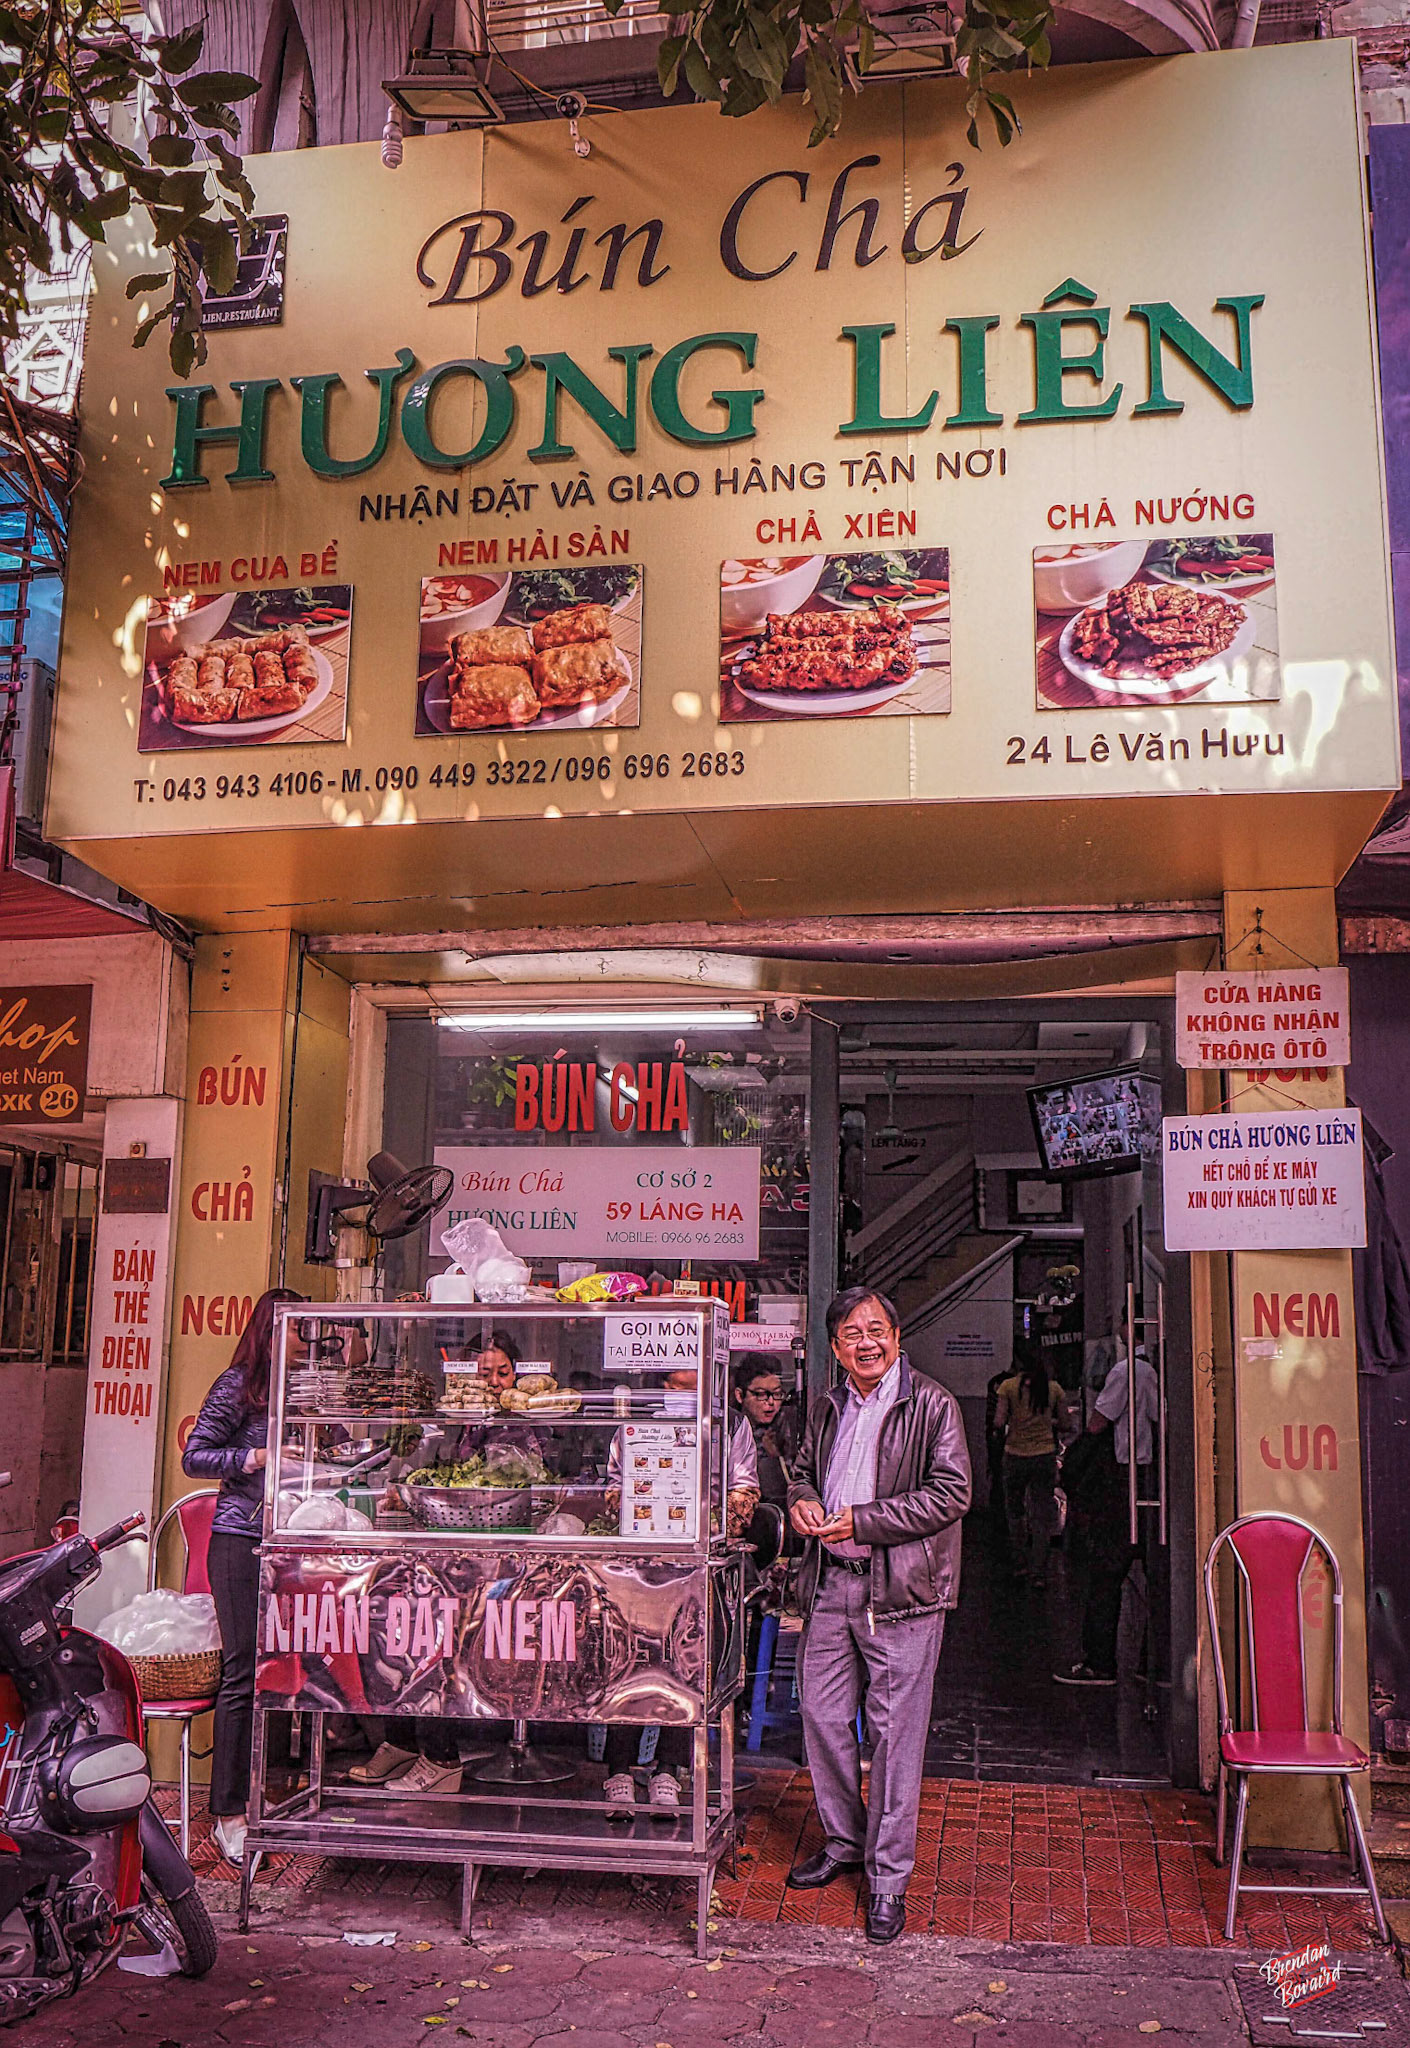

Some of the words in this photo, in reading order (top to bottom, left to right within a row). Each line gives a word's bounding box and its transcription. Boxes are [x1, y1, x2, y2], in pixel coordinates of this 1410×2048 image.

[416, 196, 671, 307] Bún
[719, 155, 985, 282] Chả
[158, 331, 765, 491] HƯƠNG
[838, 277, 1266, 437] LIÊN
[359, 485, 459, 526] NHẬN
[470, 483, 539, 519] ĐẶT
[552, 471, 596, 508] VÀ
[608, 470, 700, 503] GIAO
[714, 457, 827, 496] HÀNG
[840, 451, 915, 495] TẬN
[936, 447, 1008, 480] NƠI
[756, 511, 823, 544] CHẢ
[844, 508, 917, 540] XIÊN
[1047, 496, 1116, 530] CHẢ
[1135, 486, 1256, 527] NƯỚNG
[162, 562, 221, 589] NEM
[230, 555, 290, 583] CUA
[300, 539, 339, 577] BỂ
[438, 538, 498, 567] NEM
[508, 529, 560, 563] HẢI
[567, 523, 630, 558] SẢN
[1005, 736, 1053, 766] 24
[1066, 732, 1110, 764] Lê
[1119, 731, 1190, 762] Văn
[1202, 728, 1285, 758] Hưu
[133, 778, 155, 802] T:
[162, 777, 207, 802] 043
[216, 775, 260, 799] 943
[429, 762, 476, 789] 449
[623, 752, 670, 779] 696
[682, 750, 745, 777] 2683
[1204, 980, 1250, 1004] CỬA
[1258, 978, 1321, 1003] HÀNG
[0, 997, 80, 1064] hop
[1187, 1011, 1265, 1032] KHÔNG
[1274, 1009, 1340, 1033] NHẬN
[1199, 1039, 1275, 1061] TRÔNG
[1283, 1037, 1328, 1059] ÔTÔ
[23, 1067, 65, 1085] Nam
[197, 1054, 267, 1106] BÚN
[515, 1048, 596, 1132] BÚN
[610, 1039, 689, 1132] CHẢ
[0, 1094, 33, 1111] XK
[45, 1089, 75, 1110] 26
[1168, 1124, 1203, 1152] BÚN
[1208, 1120, 1244, 1151] CHẢ
[1247, 1122, 1312, 1148] HƯƠNG
[1315, 1116, 1357, 1145] LIÊN
[461, 1170, 511, 1192] Bún
[519, 1168, 566, 1195] Chả
[637, 1170, 664, 1188] CƠ
[670, 1167, 697, 1188] SỞ
[703, 1174, 713, 1188] 2
[1203, 1160, 1225, 1182] HẾT
[1228, 1156, 1251, 1181] CHỖ
[1254, 1156, 1270, 1180] ĐỂ
[1273, 1163, 1288, 1180] XE
[1292, 1159, 1318, 1180] MÁY
[191, 1166, 253, 1221] CHẢ
[606, 1202, 632, 1221] 59
[640, 1197, 704, 1221] LÁNG
[711, 1203, 744, 1225] HẠ
[1188, 1191, 1207, 1209] XIN
[1211, 1185, 1233, 1210] QUÝ
[1237, 1184, 1276, 1208] KHÁCH
[1280, 1187, 1296, 1211] TỰ
[1322, 1187, 1337, 1205] XE
[530, 1207, 578, 1230] LIÊN
[606, 1231, 657, 1244] MOBILE:
[661, 1232, 692, 1244] 0966
[695, 1232, 710, 1244] 96
[714, 1233, 744, 1244] 2683
[113, 1240, 156, 1282] BÁN
[113, 1282, 150, 1324] THẺ
[181, 1296, 252, 1337] NEM
[1253, 1292, 1341, 1339] NEM
[608, 1346, 627, 1358] TẠI
[632, 1340, 668, 1357] BÀN
[673, 1340, 698, 1357] ĂN
[621, 1322, 653, 1340] GỌI
[658, 1319, 698, 1337] MÓN
[102, 1328, 150, 1377] ĐIỆN
[94, 1381, 152, 1425] THOẠI
[1260, 1423, 1338, 1471] CUA
[265, 1581, 371, 1666] NHẬN
[385, 1581, 460, 1671] ĐẶT
[484, 1598, 577, 1662] NEM
